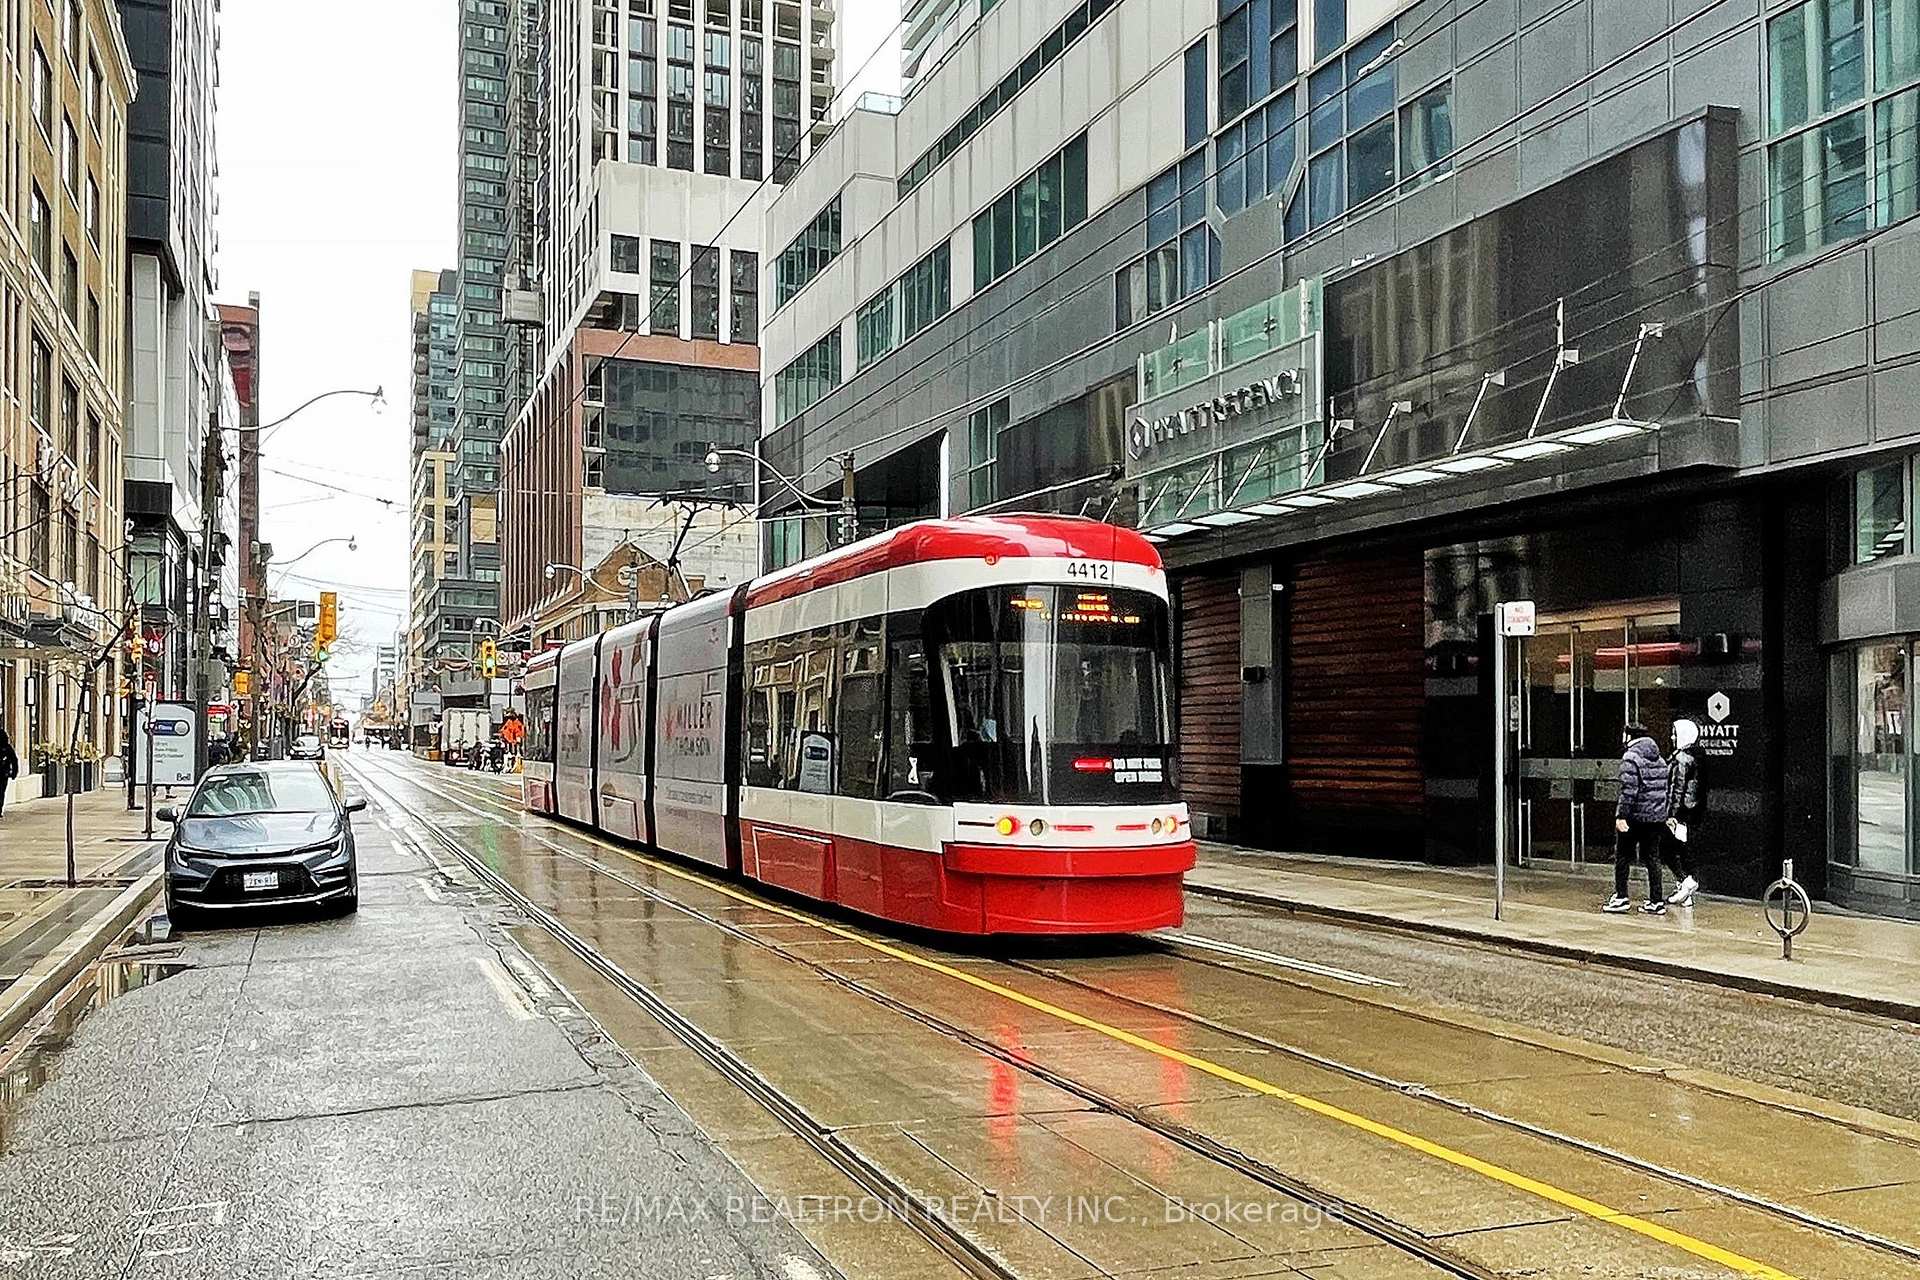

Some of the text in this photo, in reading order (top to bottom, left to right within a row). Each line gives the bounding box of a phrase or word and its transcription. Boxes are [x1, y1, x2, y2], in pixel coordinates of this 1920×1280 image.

[1152, 402, 1211, 443] HYATT
[1067, 562, 1109, 580] 4412
[1700, 724, 1739, 737] HYATT
